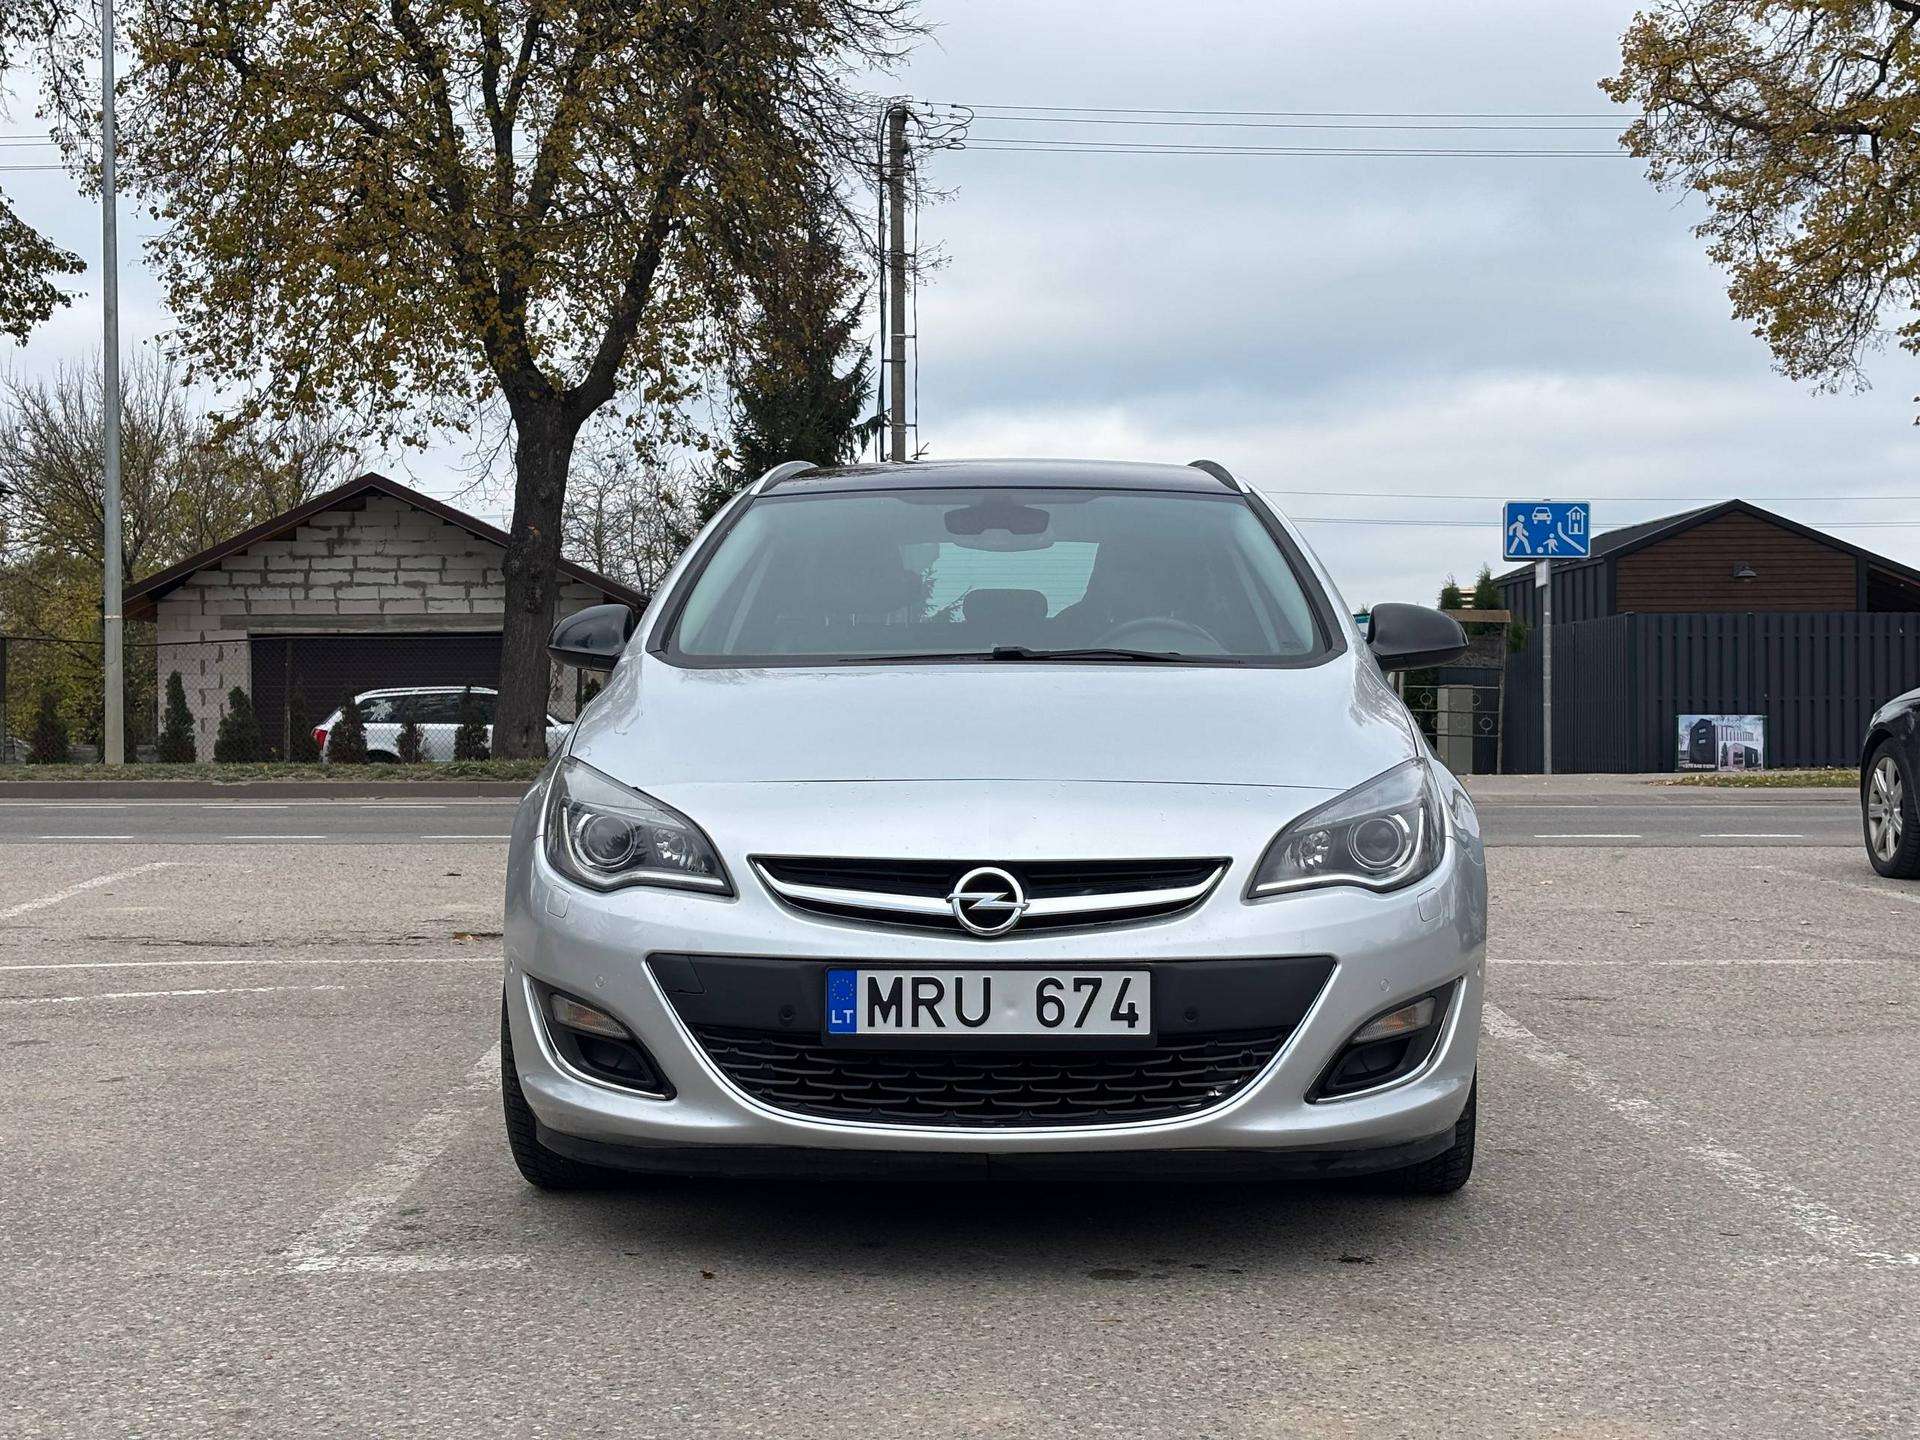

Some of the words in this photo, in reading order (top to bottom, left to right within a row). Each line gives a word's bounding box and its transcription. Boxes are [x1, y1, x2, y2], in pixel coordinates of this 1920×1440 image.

[831, 1009, 853, 1024] LT
[867, 976, 991, 1028] MRU
[1035, 977, 1139, 1028] 674
